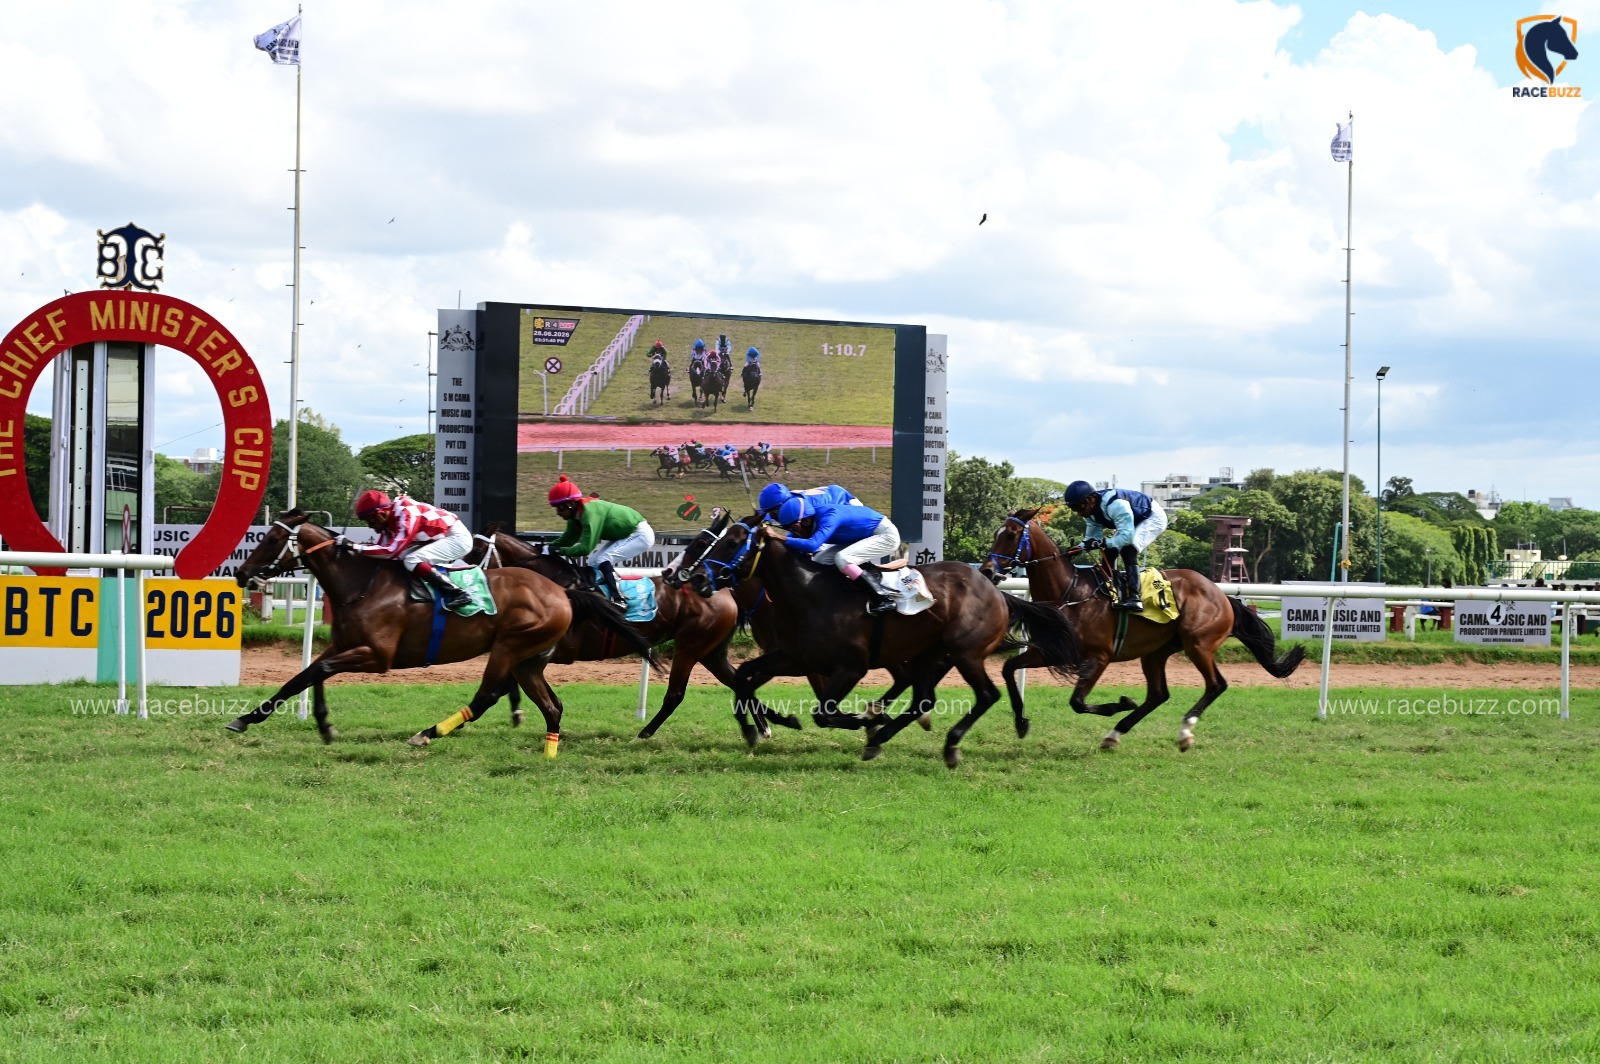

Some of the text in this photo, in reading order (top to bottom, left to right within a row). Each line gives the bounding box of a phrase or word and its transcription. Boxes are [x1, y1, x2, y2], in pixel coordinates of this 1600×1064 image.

[821, 342, 867, 357] 1:10.7
[452, 377, 463, 387] THE
[0, 308, 67, 399] CHIEF
[90, 300, 259, 408] MINISTER'S
[231, 427, 264, 491] CUP
[443, 393, 471, 402] S M CAMA
[926, 396, 936, 405] THE
[441, 408, 472, 418] MUSIC AND
[438, 424, 474, 434] PRODUCTION
[924, 425, 944, 434] SIC AND
[445, 440, 466, 449] PVT LTD
[924, 440, 945, 448] DUCTION
[443, 456, 468, 465] JUVENILE
[440, 471, 471, 481] SPRINTERS
[444, 487, 467, 496] MILLION
[923, 484, 942, 492] RINTERS
[923, 498, 938, 507] ILLION
[710, 507, 721, 519] 3
[153, 530, 190, 542] USIC
[4, 586, 236, 639] BTC 2026
[1287, 608, 1320, 622] CAMA
[1360, 610, 1381, 622] AND
[1490, 604, 1502, 622] 4
[1503, 614, 1525, 626] USIC
[1527, 614, 1547, 626] AND
[1287, 623, 1326, 632] PRODUCTIO
[1356, 624, 1381, 633] LIMITED
[1459, 627, 1546, 636] PRODUCTION PRIVATE LIMITED
